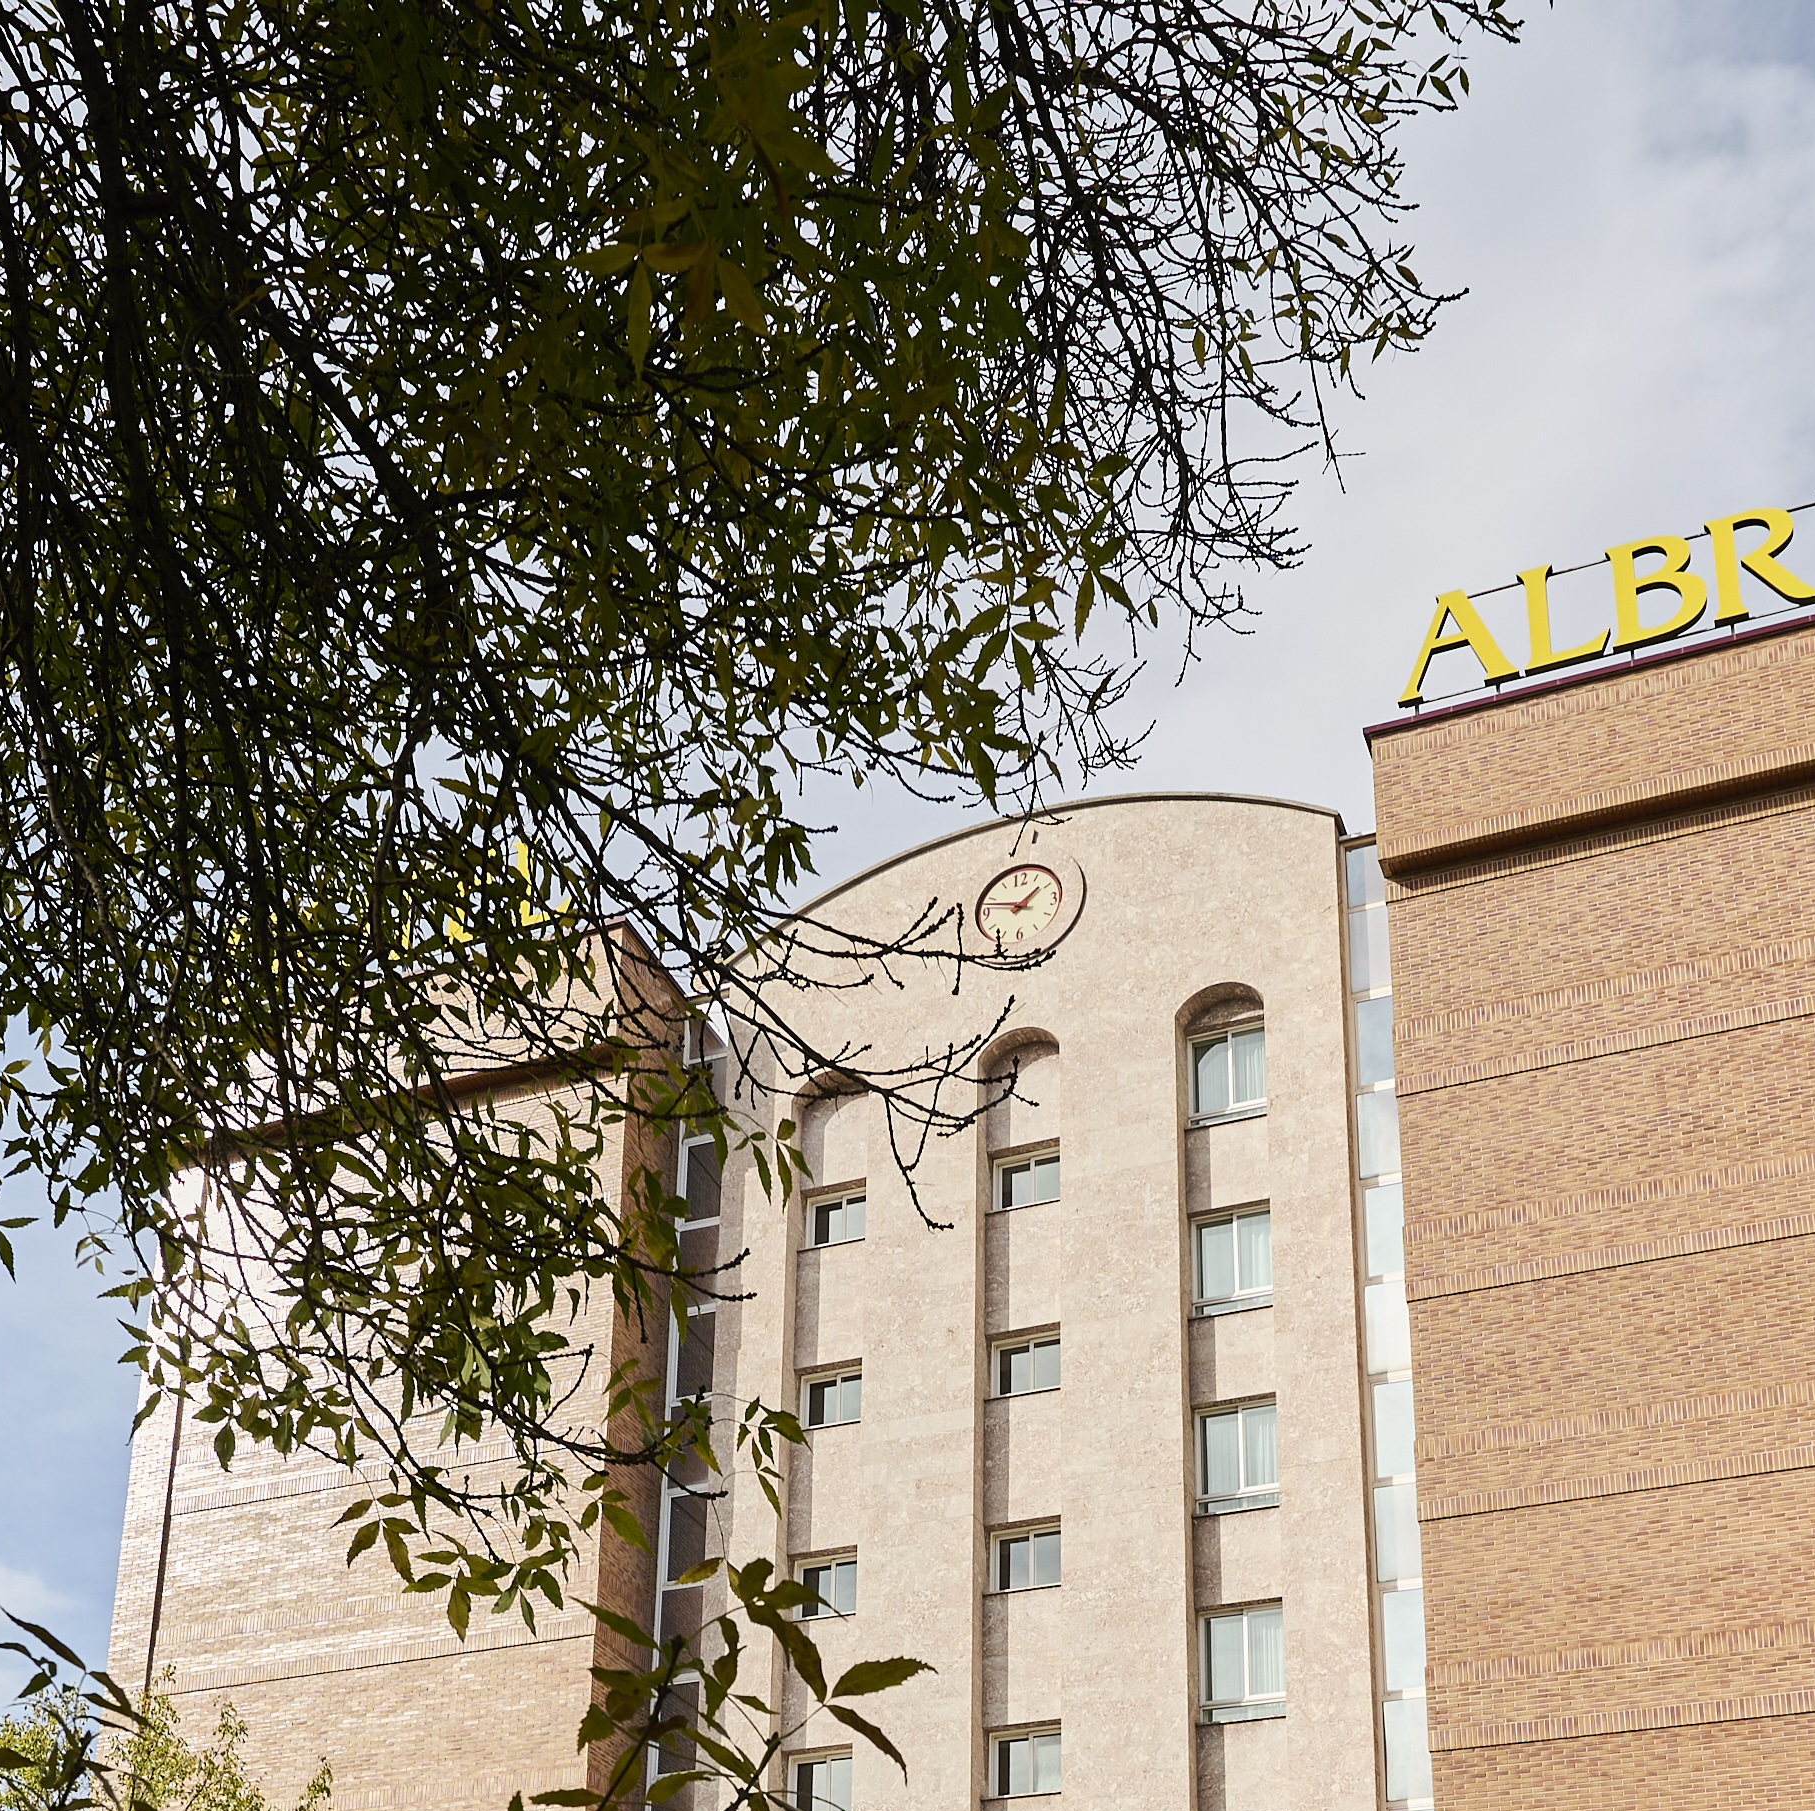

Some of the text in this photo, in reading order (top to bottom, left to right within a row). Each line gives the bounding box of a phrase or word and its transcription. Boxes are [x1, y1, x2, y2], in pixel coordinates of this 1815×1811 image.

[1013, 872, 1028, 888] 12
[1050, 891, 1057, 906] 3
[982, 907, 990, 921] 9
[1016, 926, 1023, 941] 6
